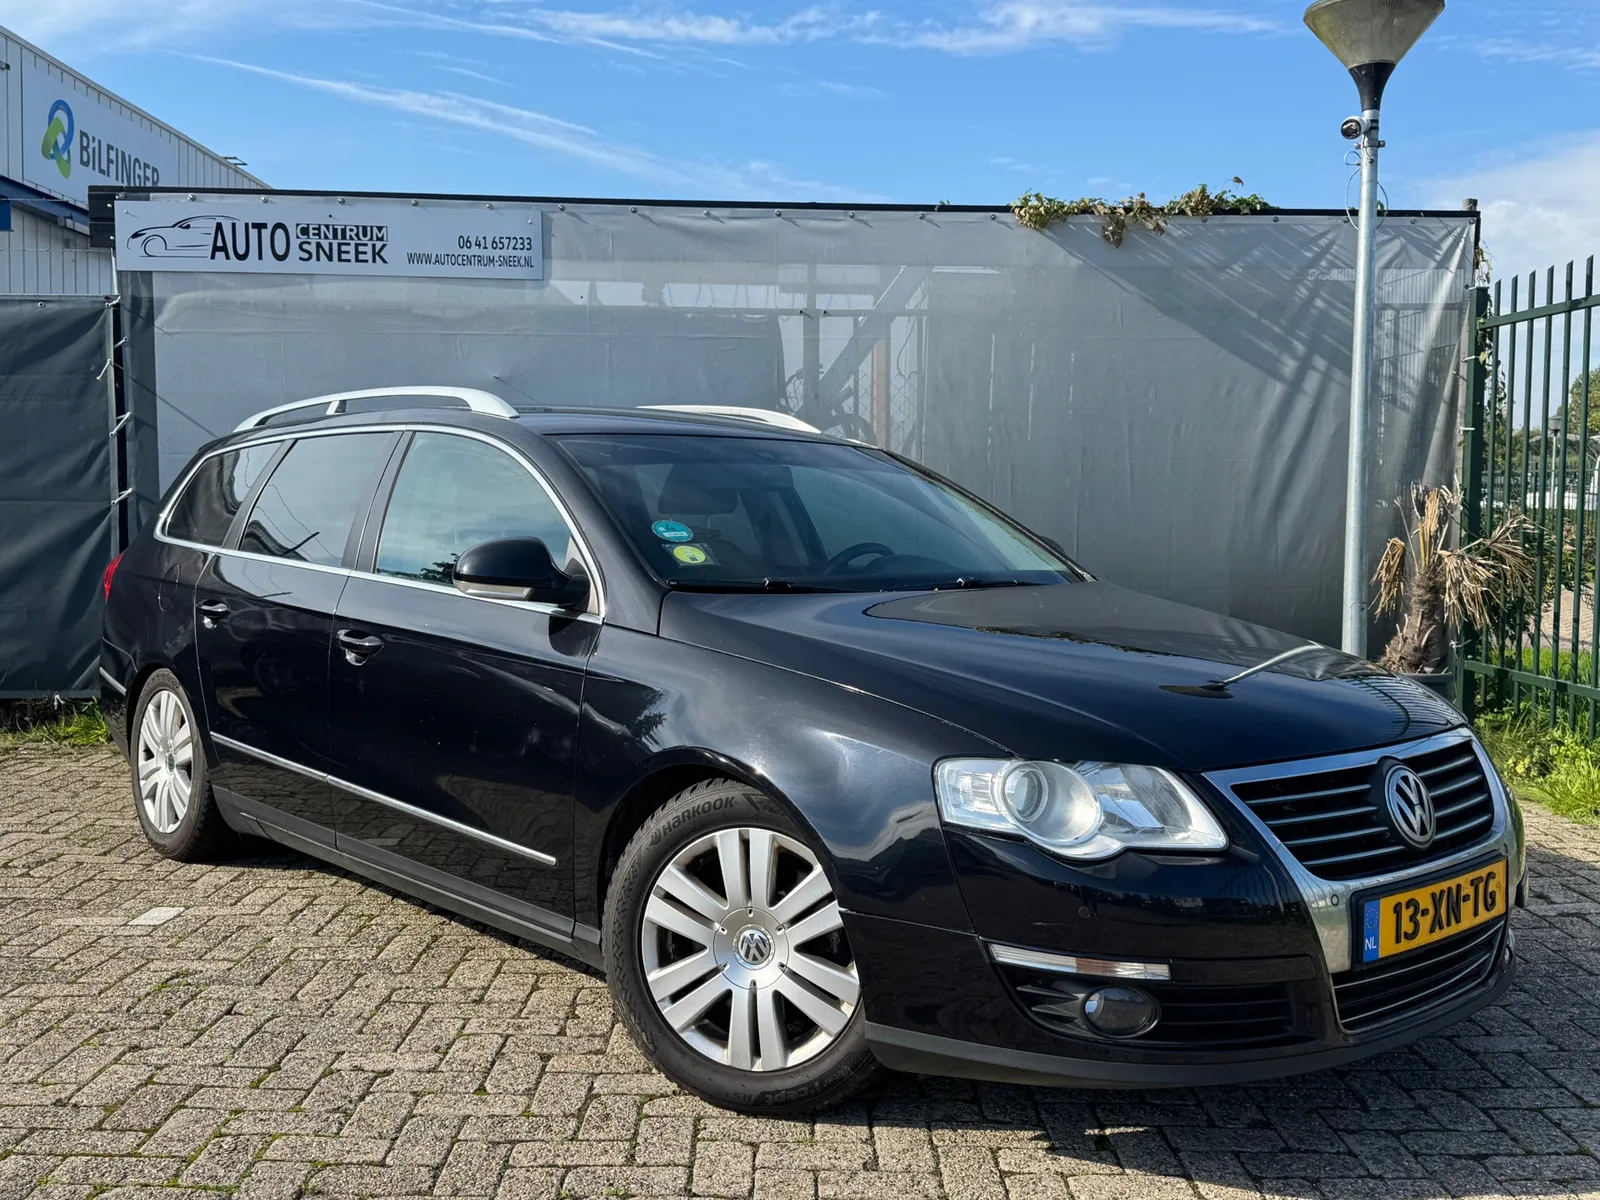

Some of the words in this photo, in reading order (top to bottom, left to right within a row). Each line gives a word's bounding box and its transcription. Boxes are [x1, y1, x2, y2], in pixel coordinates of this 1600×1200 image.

[296, 224, 388, 241] CENTRUM
[210, 222, 291, 262] AUTO
[458, 235, 472, 250] 06
[474, 236, 488, 250] 41
[491, 236, 533, 251] 657233
[298, 241, 389, 264] SNEEK
[407, 252, 535, 268] WWW.AUTOCENTRUM-SNEEK.NL
[1393, 871, 1497, 944] 13-XN-TG
[1364, 935, 1378, 951] NL
